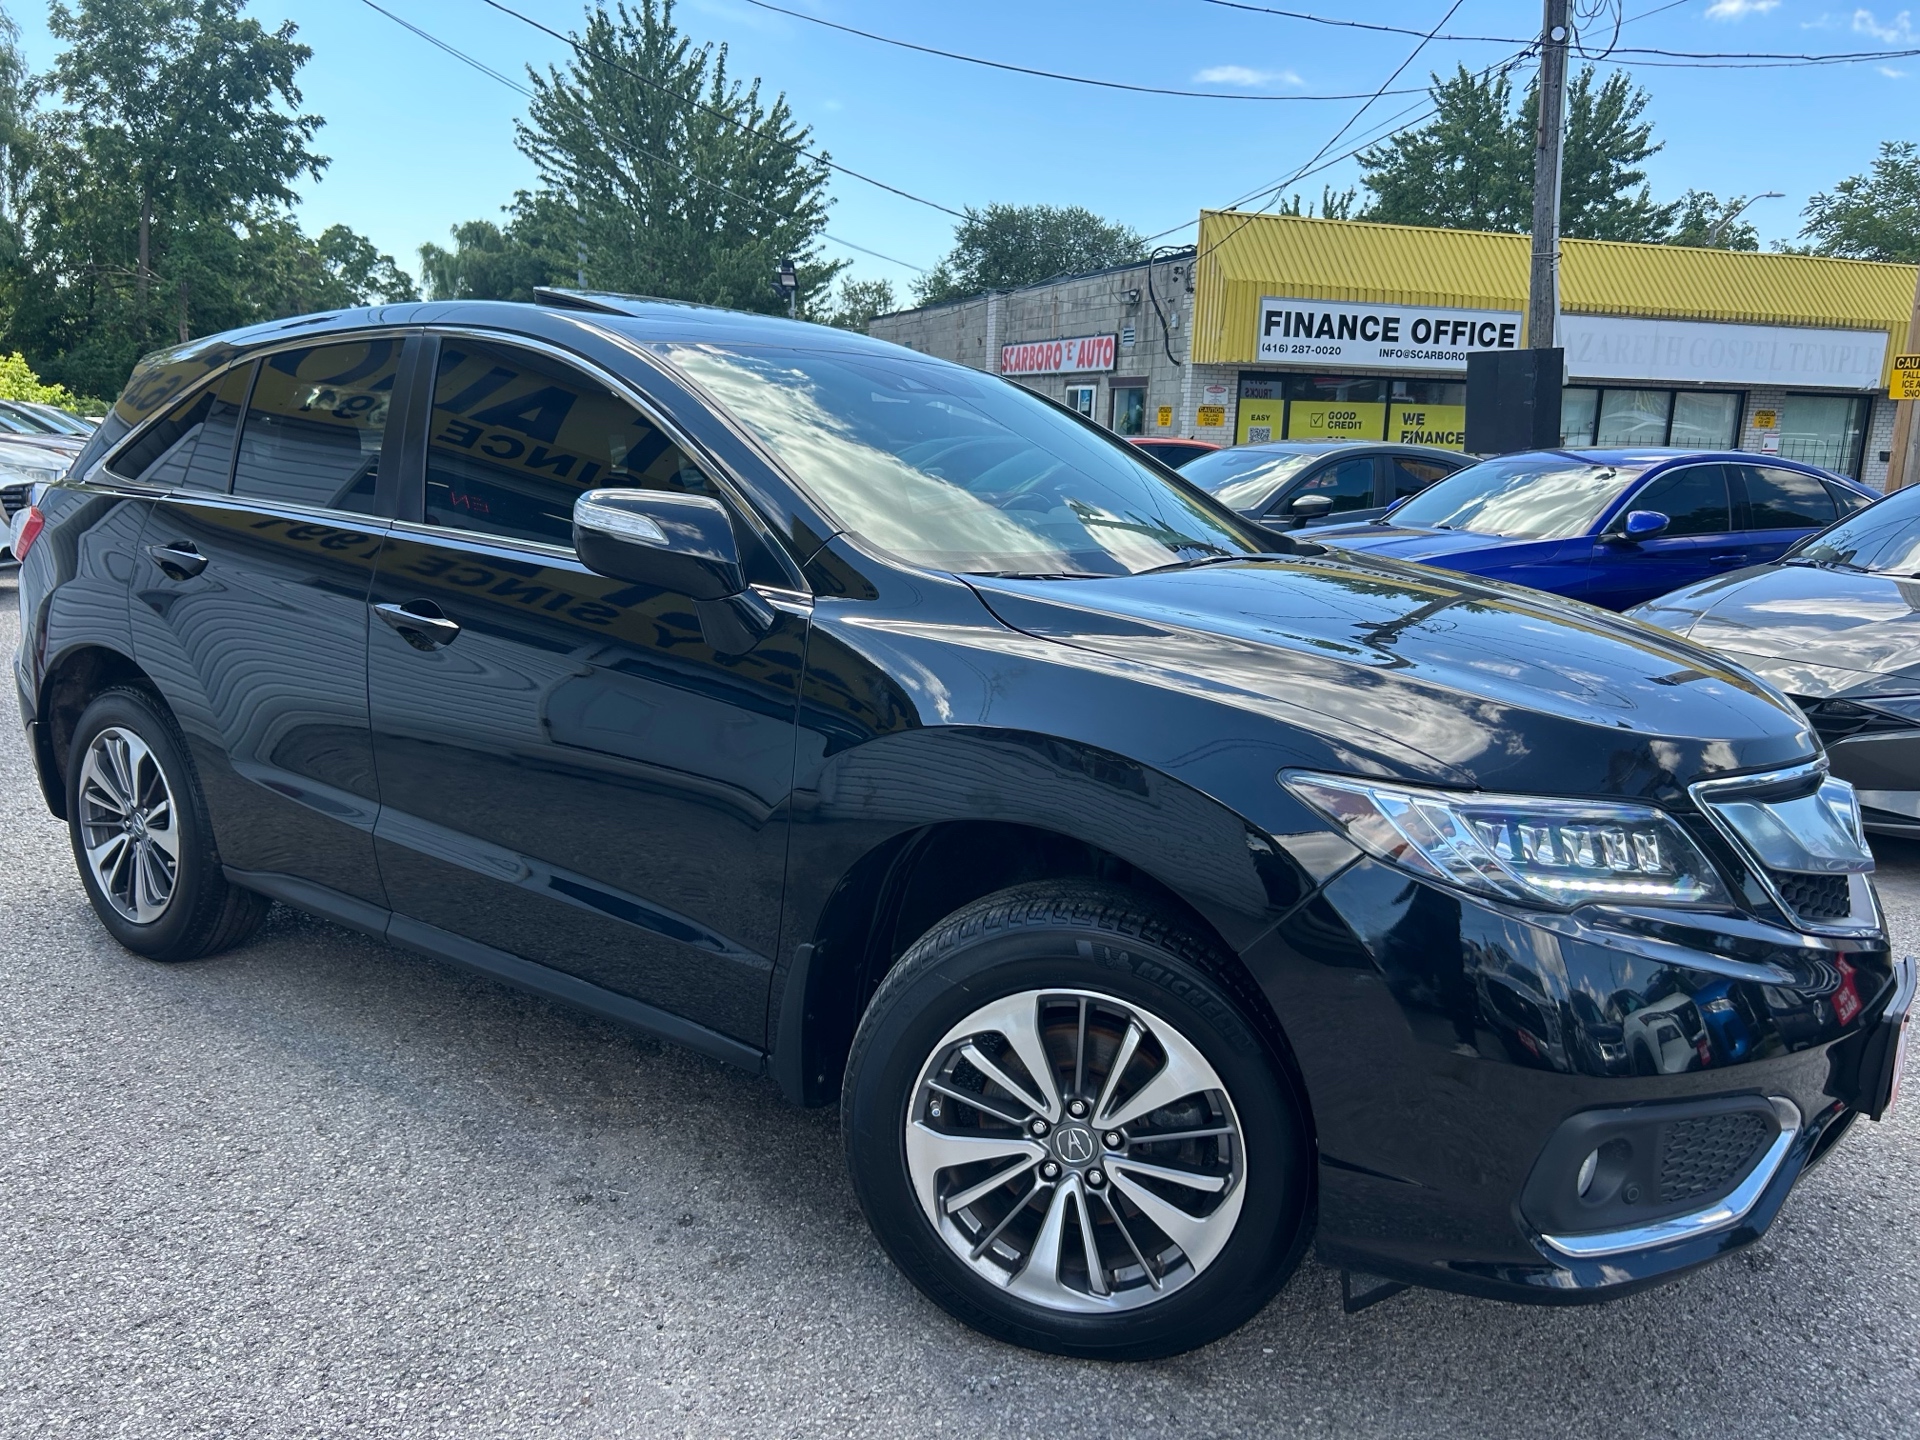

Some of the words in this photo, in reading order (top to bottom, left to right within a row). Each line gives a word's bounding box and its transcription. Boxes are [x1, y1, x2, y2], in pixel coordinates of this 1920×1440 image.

[1264, 310, 1400, 343] FINANCE
[1410, 318, 1516, 348] OFFICE
[1002, 342, 1062, 372] SCARBORO
[1076, 336, 1113, 369] AUTO
[1261, 342, 1288, 354] (416)
[1291, 344, 1342, 356] 287-0020
[1379, 348, 1468, 361] INFO@SCARBORO
[1565, 332, 1684, 367] AZARETH
[1328, 411, 1357, 421] GOOD
[1402, 412, 1425, 426] WE
[1327, 420, 1363, 430] CREDIT
[1400, 430, 1466, 445] FINANCE
[1136, 962, 1254, 1049] MICHELIN
